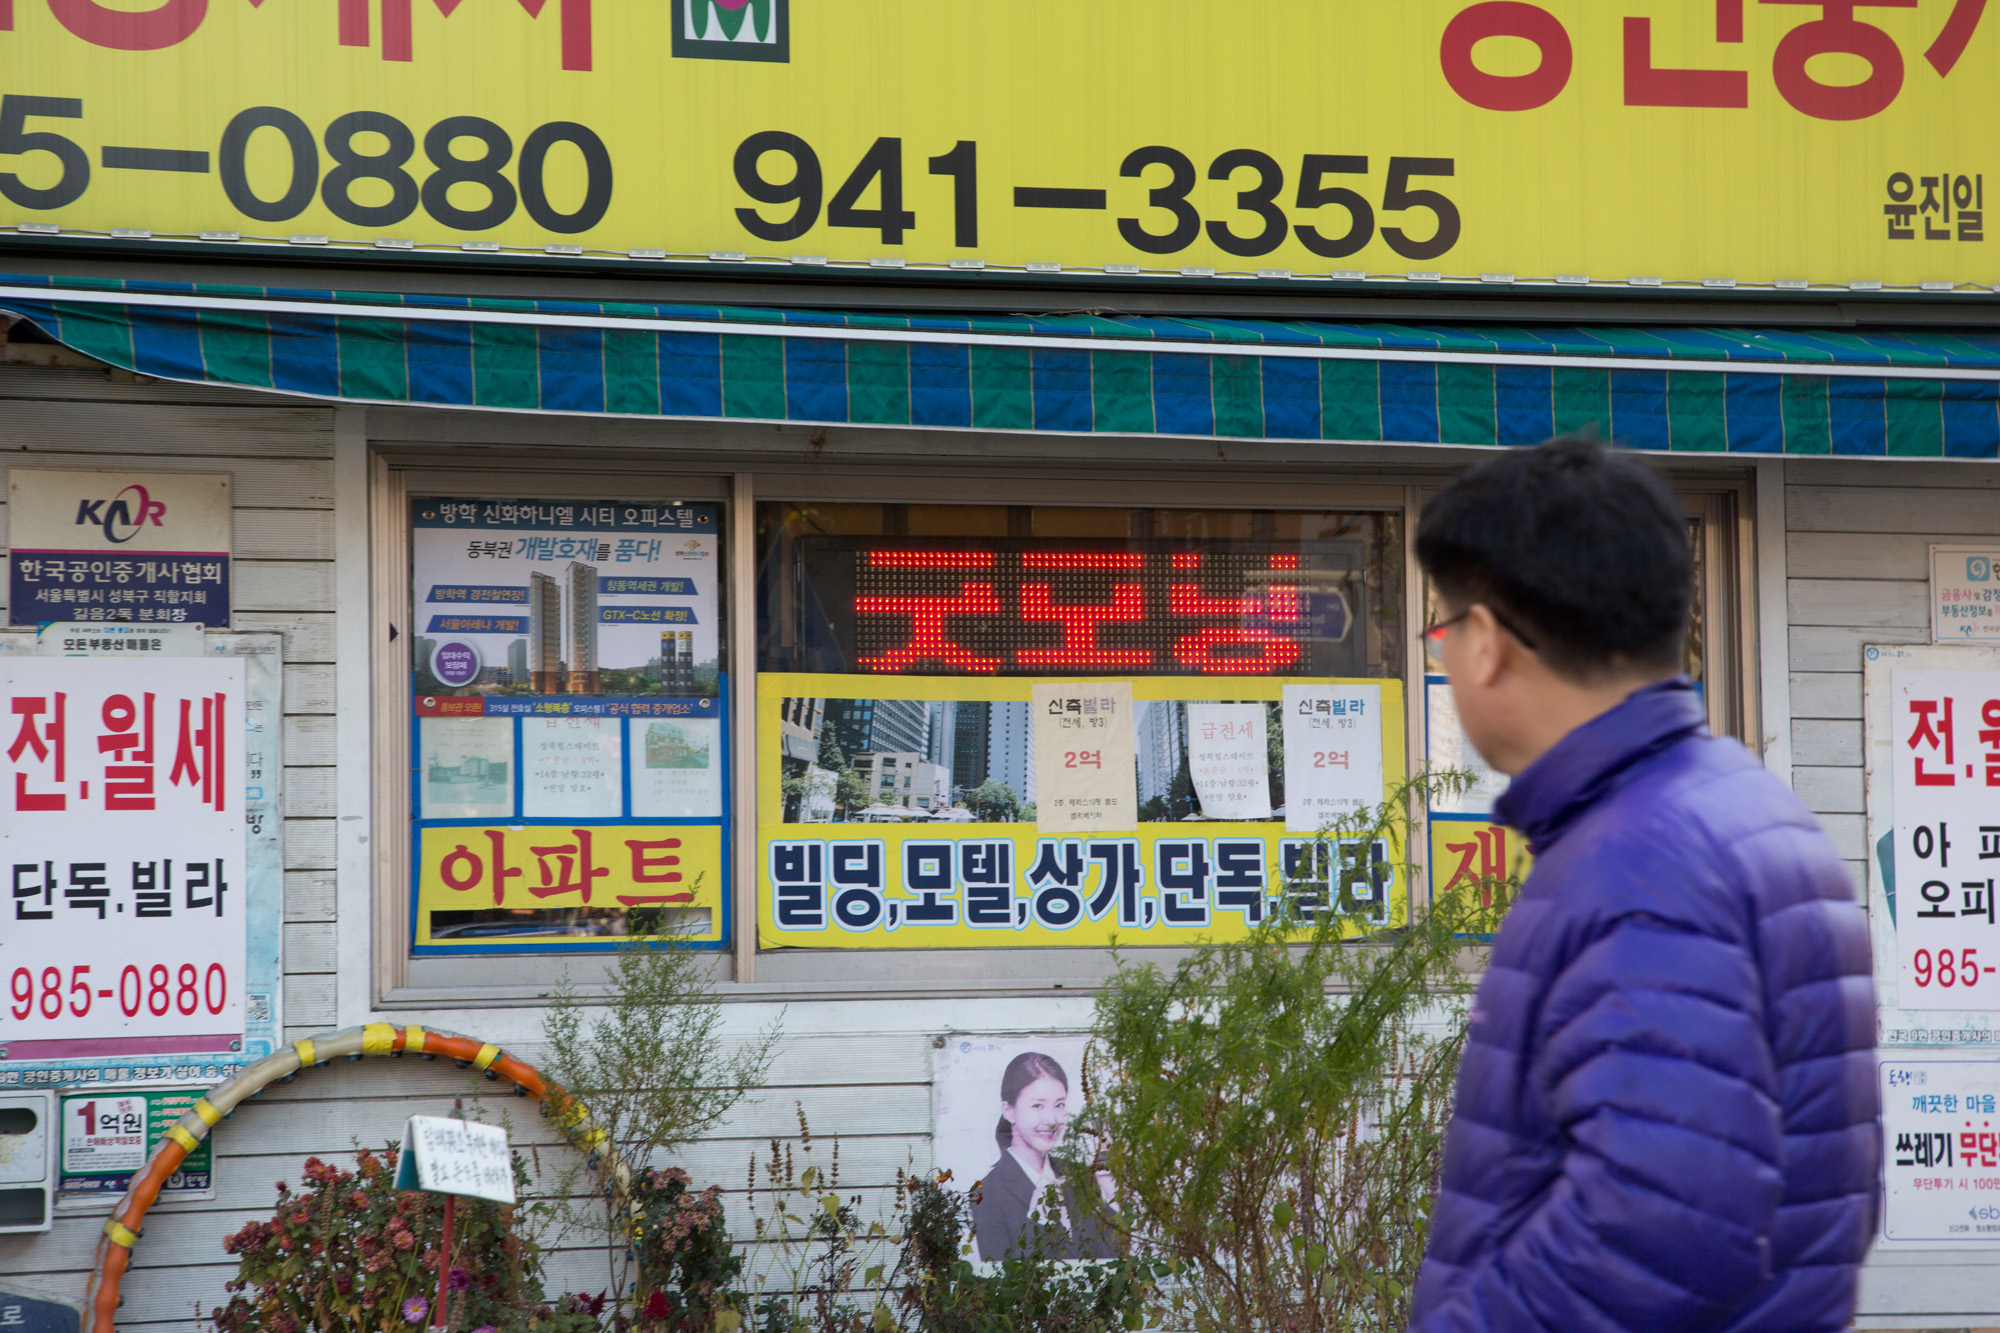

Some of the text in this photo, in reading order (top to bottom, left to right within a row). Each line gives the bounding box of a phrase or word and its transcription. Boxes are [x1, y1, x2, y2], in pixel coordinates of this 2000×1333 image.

[733, 130, 1461, 260] 941-3355
[1884, 171, 1983, 242] 윤진일
[440, 504, 694, 528] 방학 신화하니엘 시티 오피스텔
[467, 537, 661, 563] 동북권 개발호재를 품다!
[19, 560, 222, 584] 한국공인중개사협회
[435, 588, 467, 600] 방학역
[607, 580, 684, 592] 창동역세권 개발!
[1942, 588, 1972, 602] 금융사
[35, 588, 207, 604] 서울특별시 성북구 직할지회
[138, 608, 188, 622] 분회장
[664, 610, 688, 622] 확정!
[440, 619, 519, 631] 서울아레나 개발!
[64, 639, 161, 651] 모든 부동산 매물은
[440, 702, 463, 713] 홍보관
[573, 704, 600, 713] 오피스텔
[631, 703, 650, 714] 협력
[1049, 697, 1116, 714] 신축빌라
[1299, 699, 1365, 715] 신축빌라
[1200, 721, 1253, 740] 급전세
[7, 691, 226, 812] 전.월세
[1064, 750, 1101, 769] 2억
[1313, 751, 1349, 769] 2억
[440, 829, 695, 907] 아파트
[12, 858, 228, 920] 단독.빌라
[1917, 878, 1995, 924] 오피
[11, 962, 227, 1020] 985-0880
[1931, 1029, 1992, 1042] 공인중개사의
[23, 1068, 101, 1084] 공인중개사의
[132, 1066, 173, 1080] 정보가
[205, 1065, 218, 1078] 숨
[1912, 1094, 1996, 1114] 깨끗한 마을
[1896, 1132, 2000, 1168] 쓰레기 무단
[1914, 1178, 1954, 1190] 무단투기
[1958, 1178, 1968, 1190] 시
[0, 1305, 25, 1325] 로
